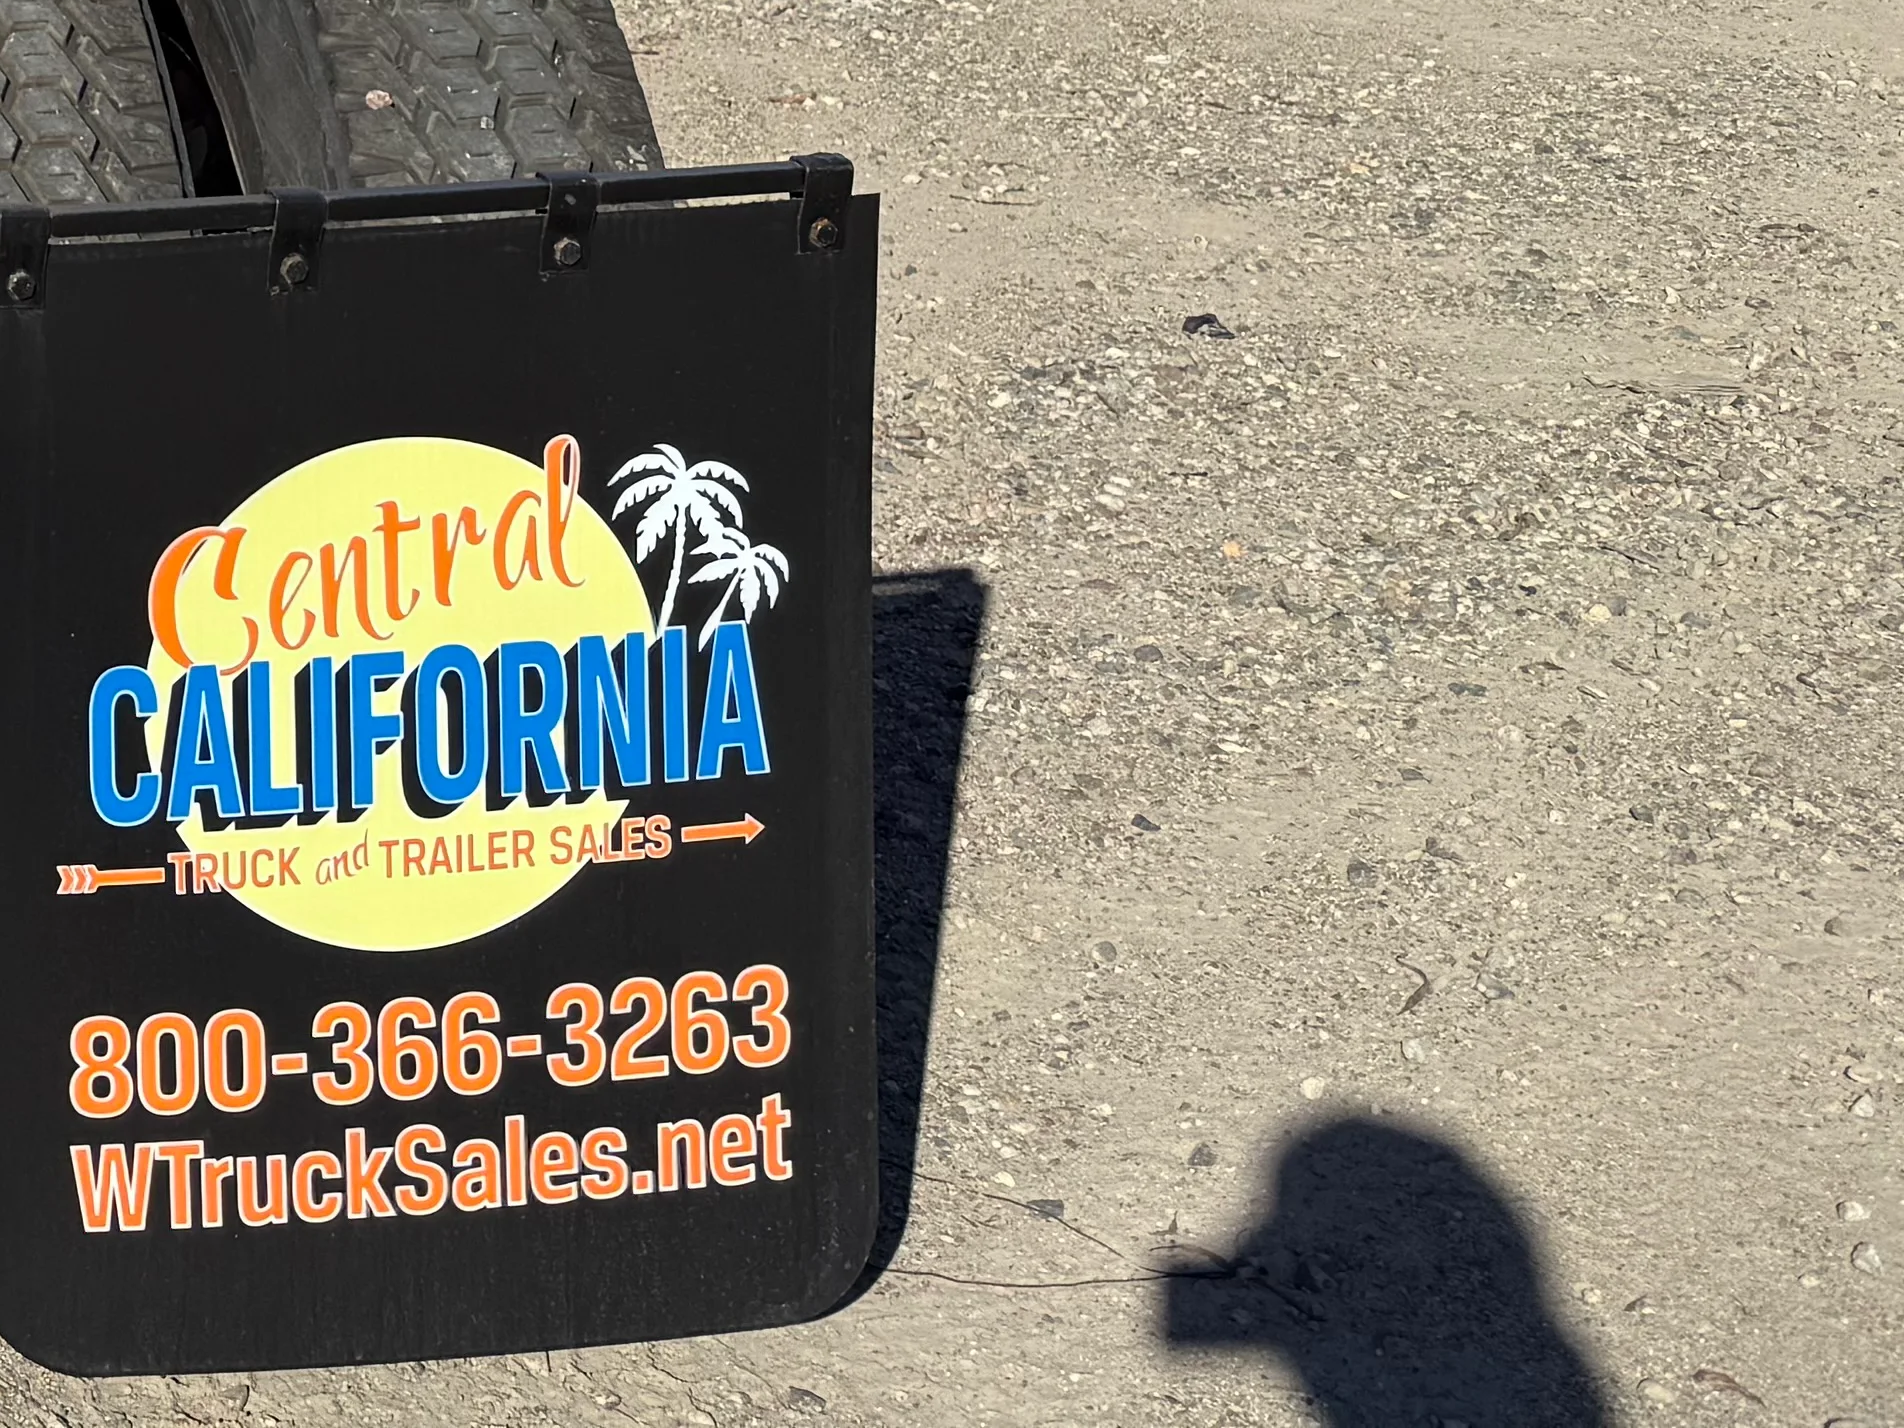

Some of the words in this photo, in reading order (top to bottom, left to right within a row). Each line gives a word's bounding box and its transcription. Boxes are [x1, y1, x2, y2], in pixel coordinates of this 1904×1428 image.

[147, 434, 581, 676] Central
[88, 619, 772, 829] CALIFORNIA
[166, 845, 302, 897] TRUCK
[316, 830, 371, 888] and
[378, 829, 535, 879] TRAILER
[549, 816, 673, 866] SALES
[68, 965, 793, 1120] 800-366-3263
[70, 1093, 794, 1233] WTruckSales.net
